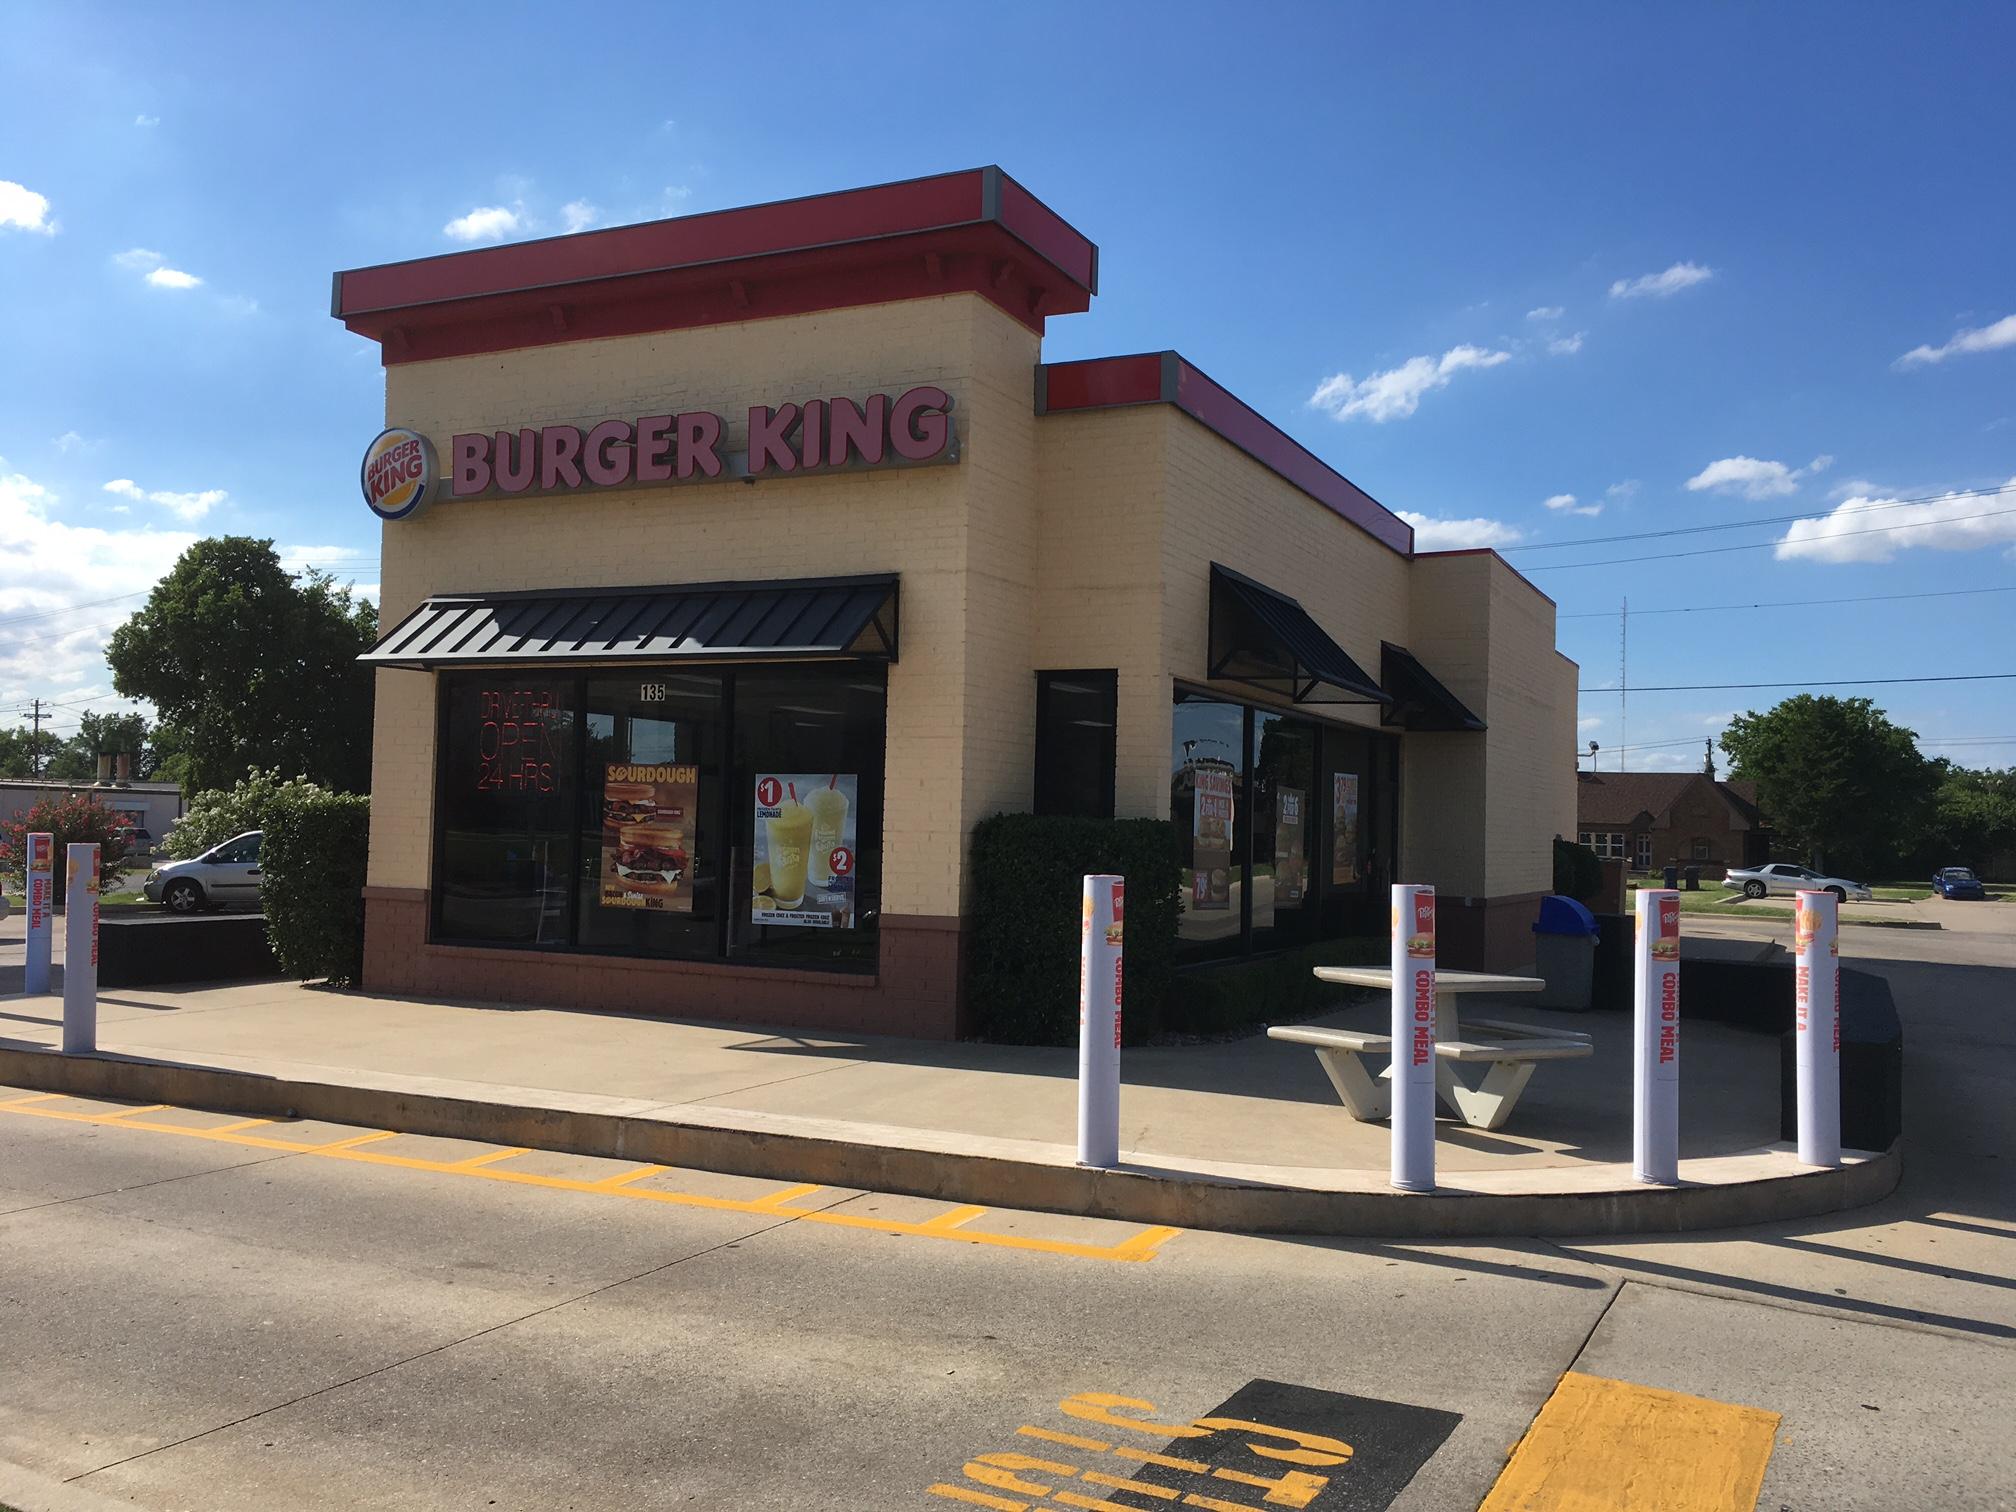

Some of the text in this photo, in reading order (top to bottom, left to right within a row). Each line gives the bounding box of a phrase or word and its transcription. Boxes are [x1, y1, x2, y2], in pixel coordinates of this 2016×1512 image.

[367, 439, 420, 482] BURGER
[452, 386, 951, 496] BURGER KING
[370, 454, 423, 504] KING
[641, 684, 665, 701] 135
[478, 762, 554, 792] 24 HRS
[607, 765, 697, 784] SOURDOUGH
[832, 850, 848, 871] $2
[31, 878, 43, 929] COMBO MEAL
[1413, 969, 1431, 1067] COMBO MEAL
[1659, 972, 1676, 1064] COMBO MEAL
[1797, 966, 1810, 1031] MAKE IT A
